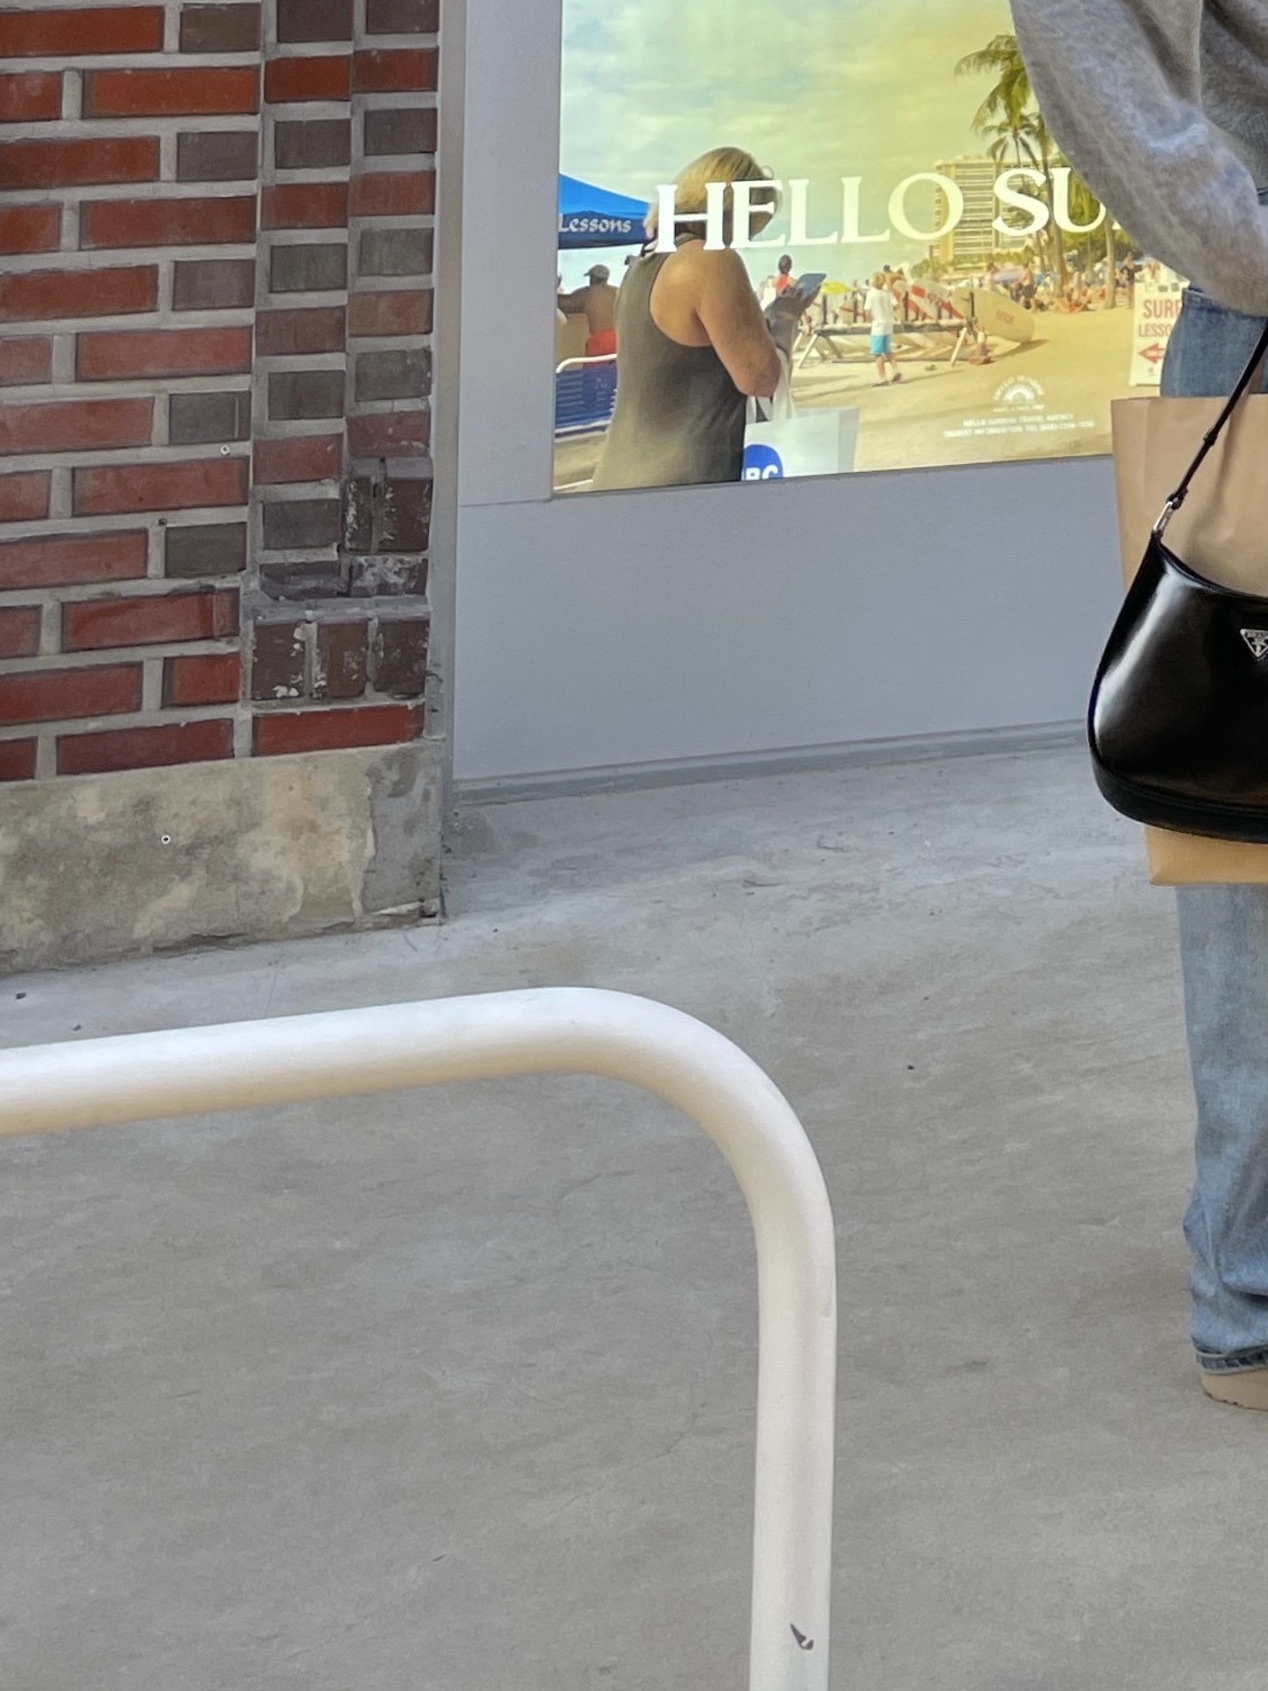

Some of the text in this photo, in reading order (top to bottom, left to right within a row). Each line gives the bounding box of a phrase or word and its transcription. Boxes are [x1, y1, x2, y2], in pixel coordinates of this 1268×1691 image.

[558, 213, 632, 233] Lessons
[656, 167, 1121, 253] HELLO SU
